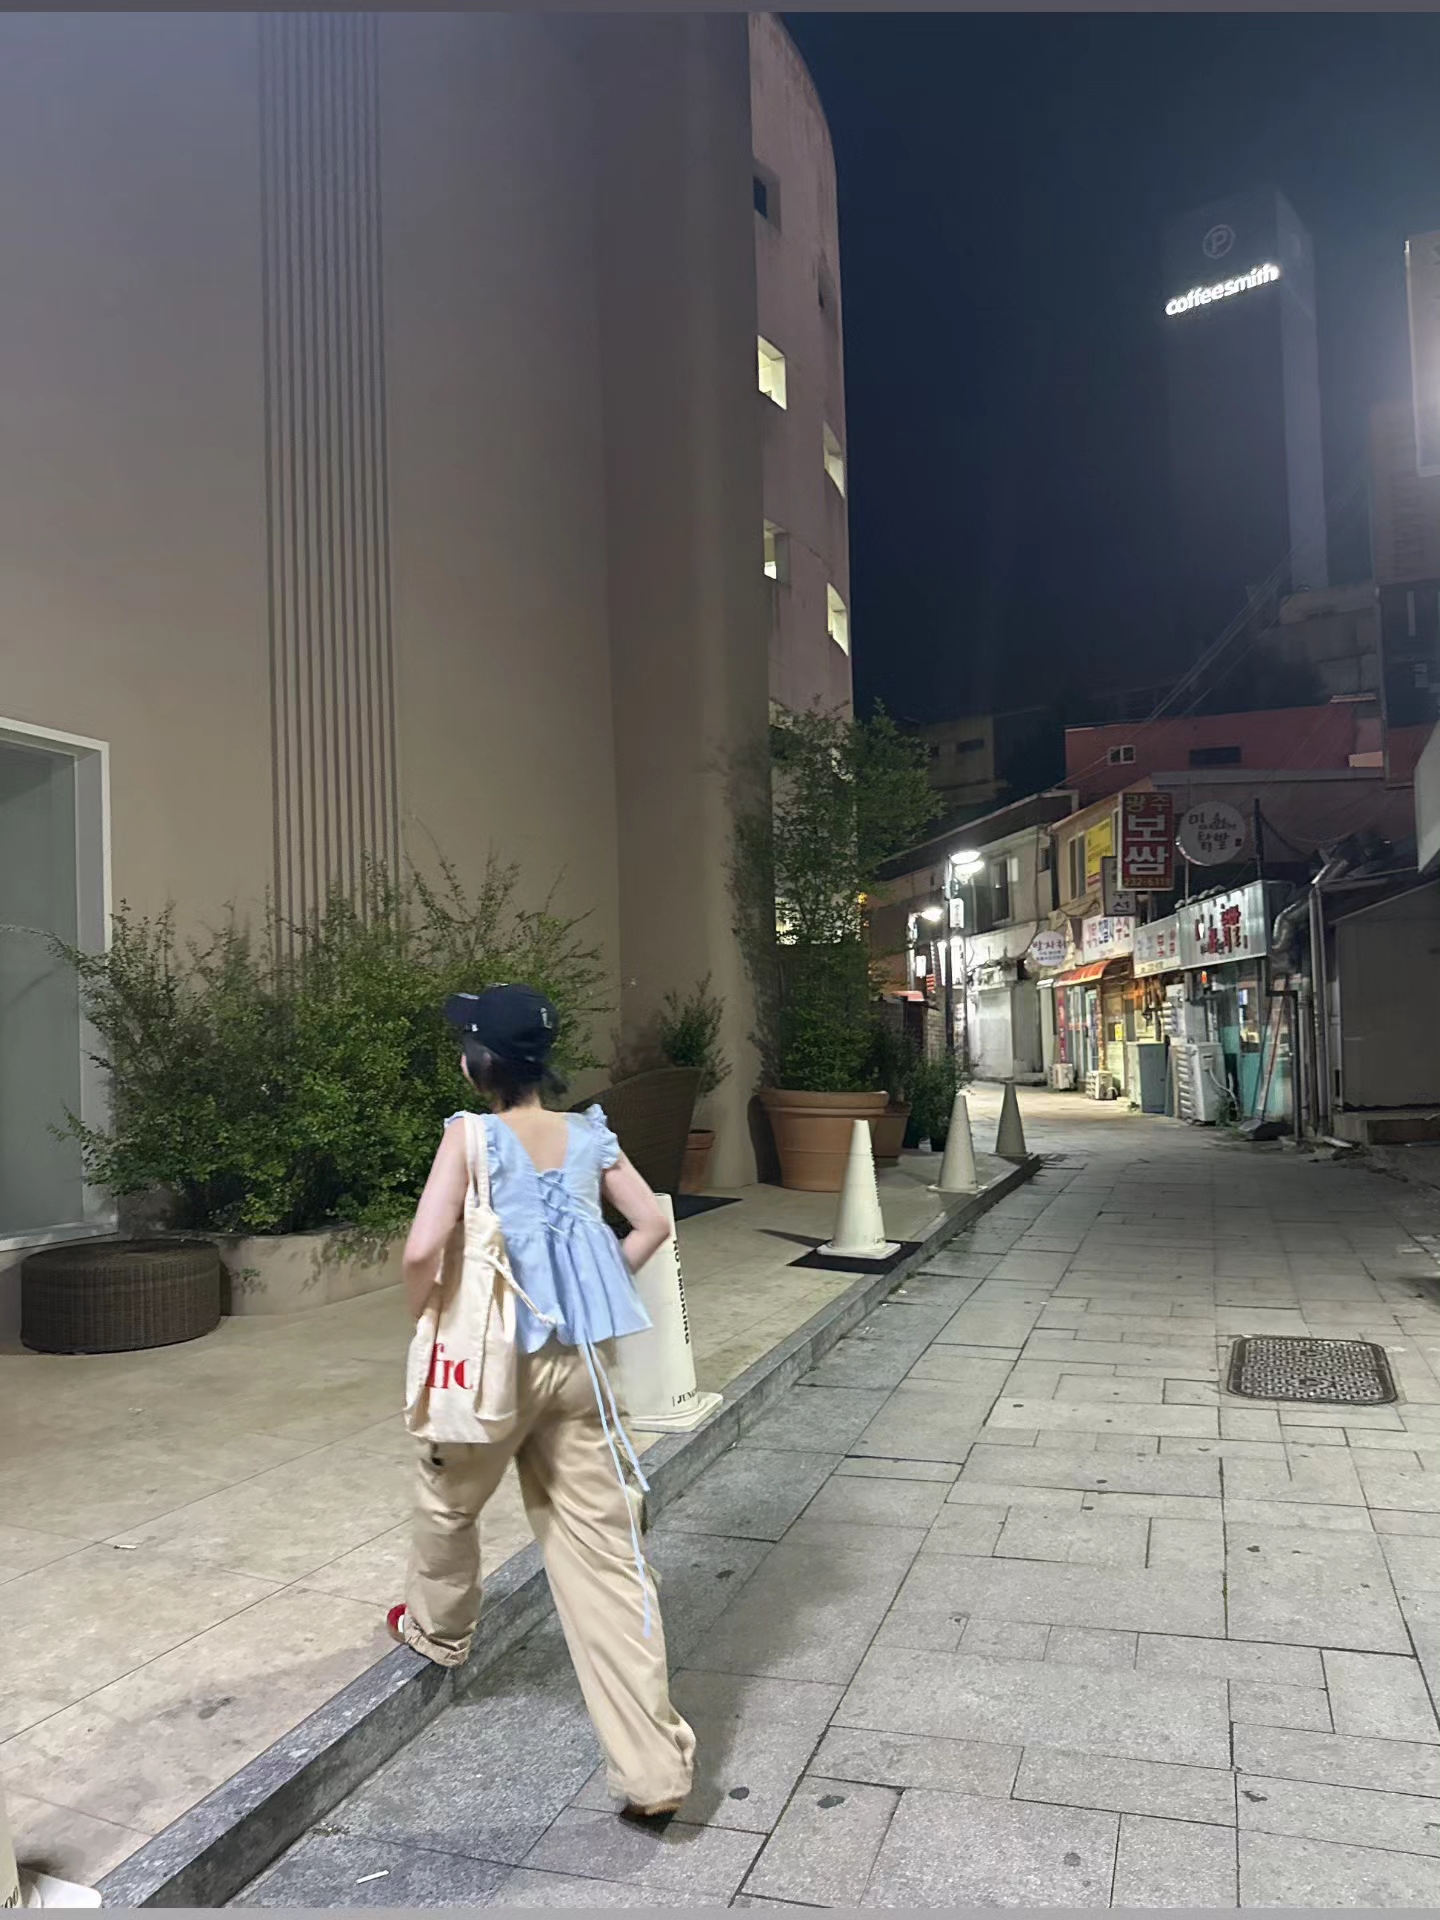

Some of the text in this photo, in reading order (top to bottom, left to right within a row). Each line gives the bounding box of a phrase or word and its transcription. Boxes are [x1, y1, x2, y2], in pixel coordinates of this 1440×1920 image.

[1165, 263, 1280, 316] coffeesmith
[1124, 815, 1170, 875] 보쌈
[677, 1268, 690, 1345] SMOKING
